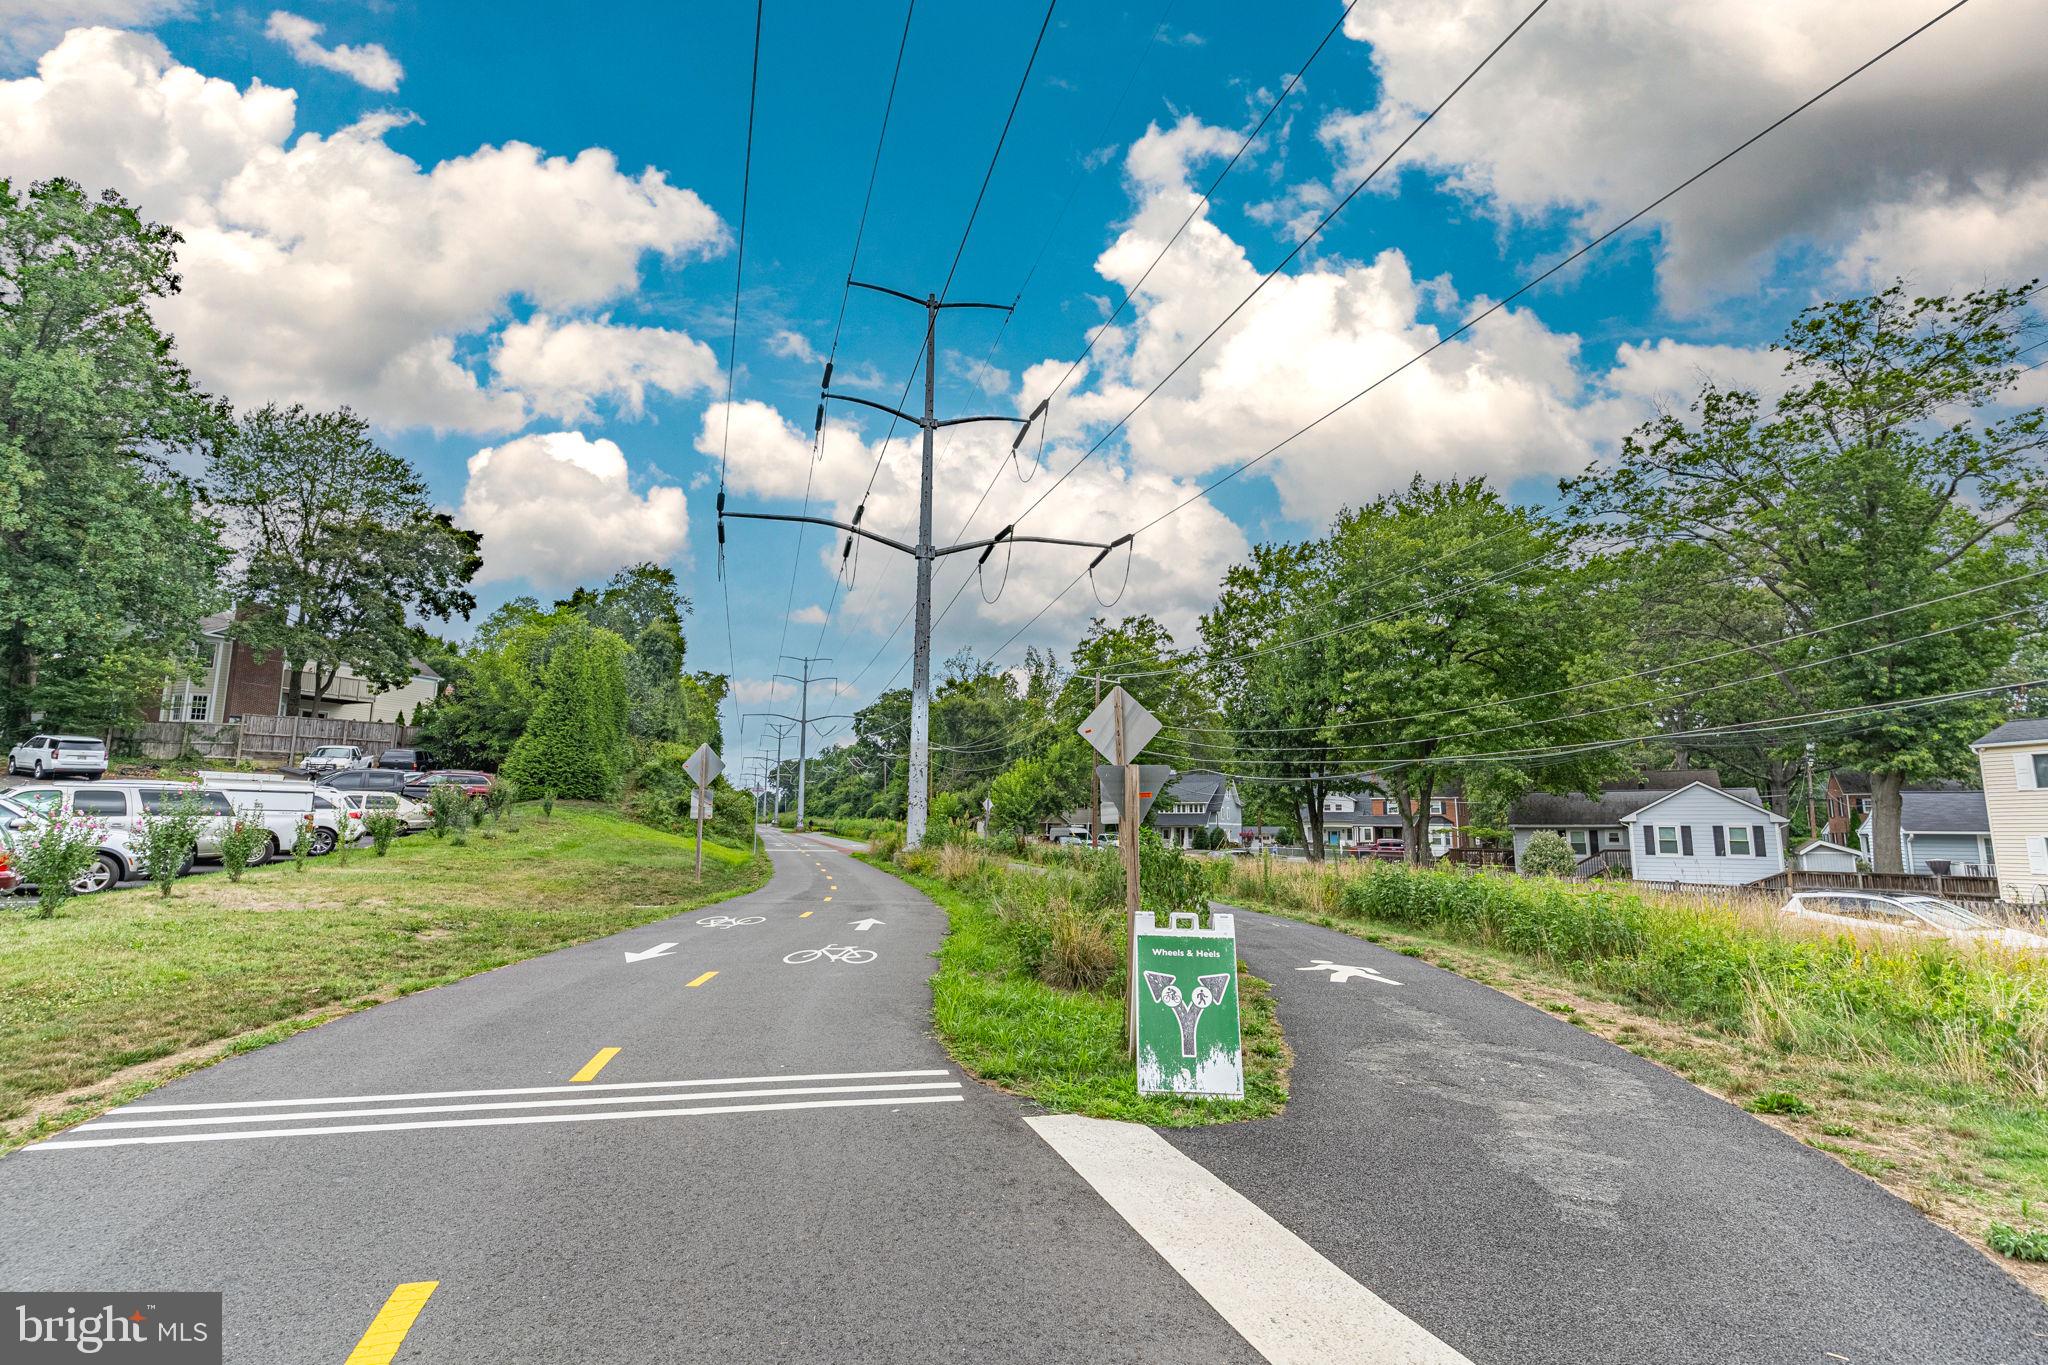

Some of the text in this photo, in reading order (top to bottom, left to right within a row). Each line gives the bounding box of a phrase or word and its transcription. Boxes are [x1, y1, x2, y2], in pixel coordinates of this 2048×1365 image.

[1151, 948, 1221, 958] Wheels & Heels
